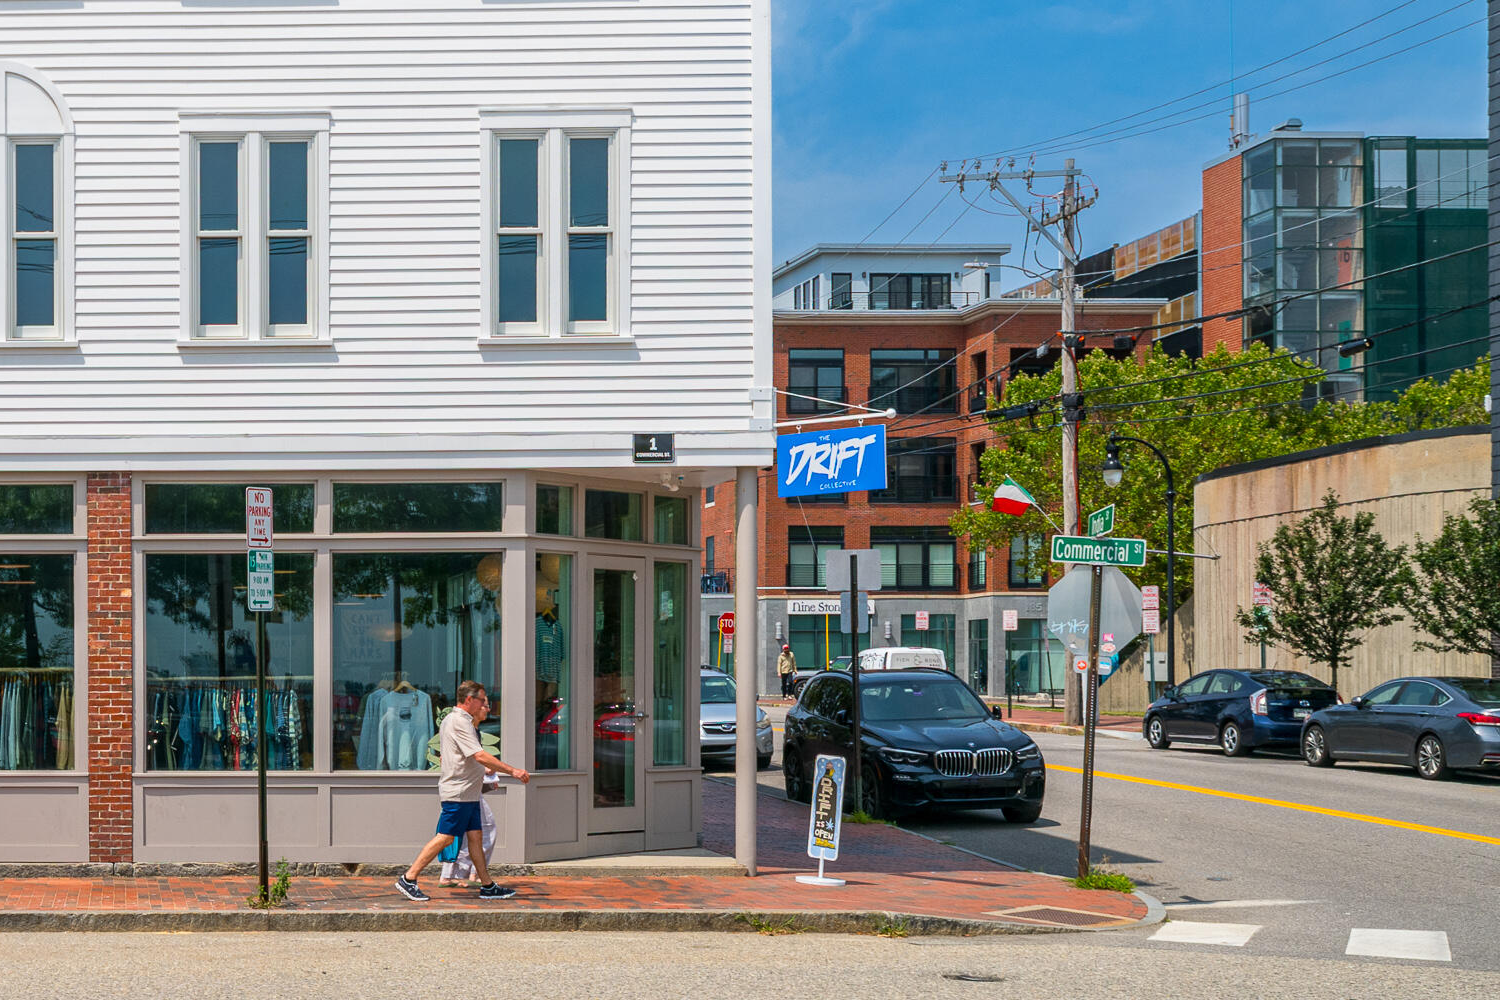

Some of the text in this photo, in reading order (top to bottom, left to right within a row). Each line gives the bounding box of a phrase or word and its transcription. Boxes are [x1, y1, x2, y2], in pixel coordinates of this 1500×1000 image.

[649, 437, 658, 450] 1
[785, 434, 876, 486] DRIFT
[819, 480, 857, 490] COLLECTIVE
[254, 492, 265, 504] NO
[249, 506, 271, 518] PARKING
[254, 519, 265, 527] ANY
[1091, 514, 1105, 536] India
[253, 528, 266, 536] TIME
[1055, 539, 1142, 562] Commercial St
[250, 555, 256, 568] 15
[263, 576, 269, 585] AM
[250, 589, 256, 597] TO
[792, 601, 816, 612] Nine
[720, 618, 734, 628] STO
[816, 777, 834, 820] DRIFT
[814, 829, 834, 840] OPEN
